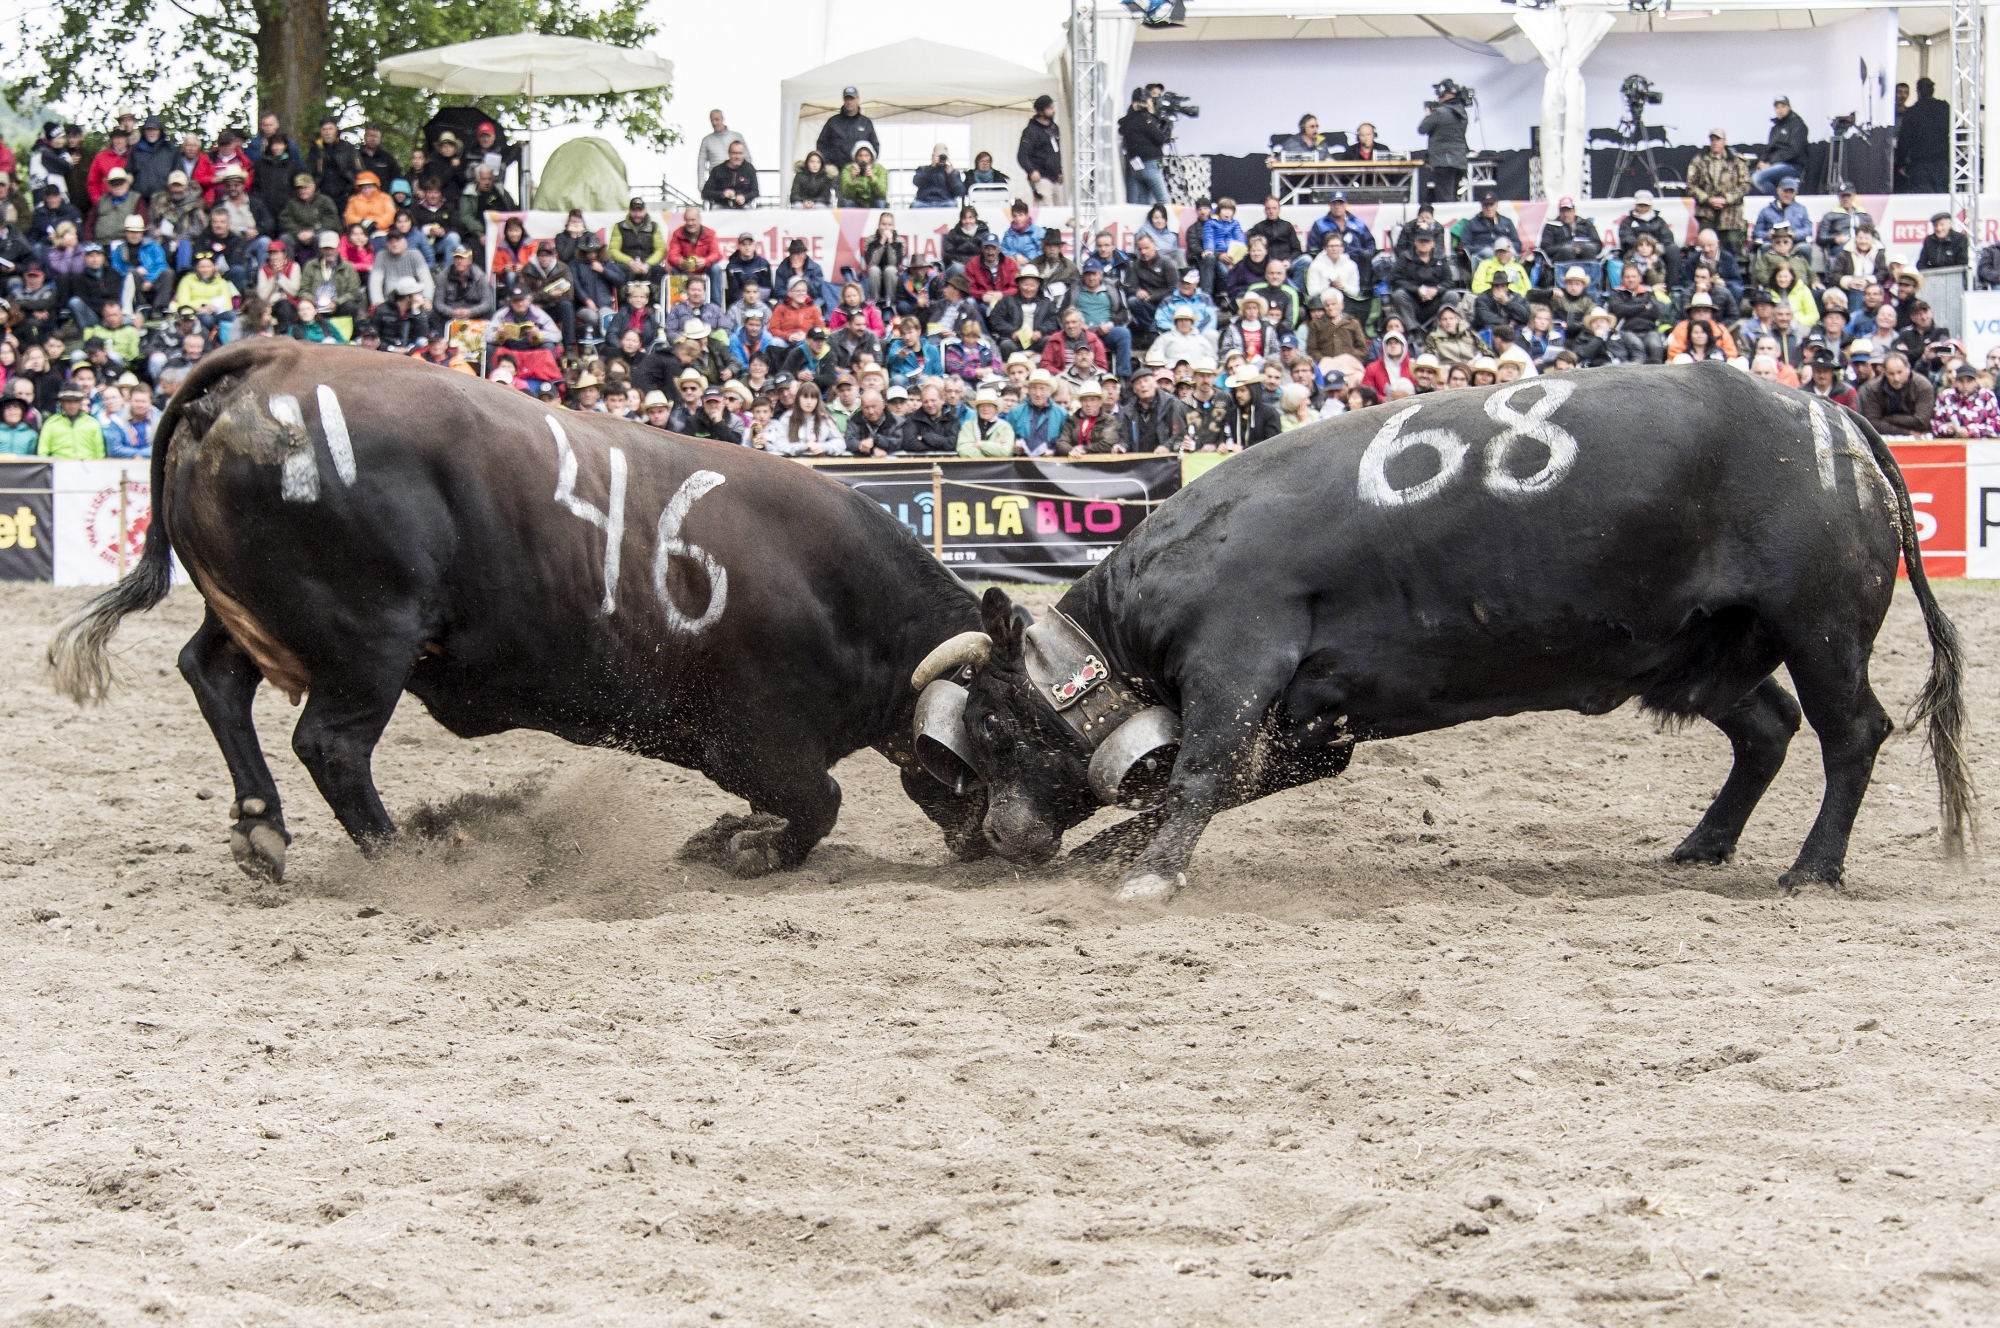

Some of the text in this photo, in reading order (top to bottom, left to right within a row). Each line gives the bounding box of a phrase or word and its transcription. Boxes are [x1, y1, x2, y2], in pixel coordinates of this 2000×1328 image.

[1895, 223, 1928, 240] RTS
[1358, 378, 1578, 507] 68
[545, 414, 728, 635] 46
